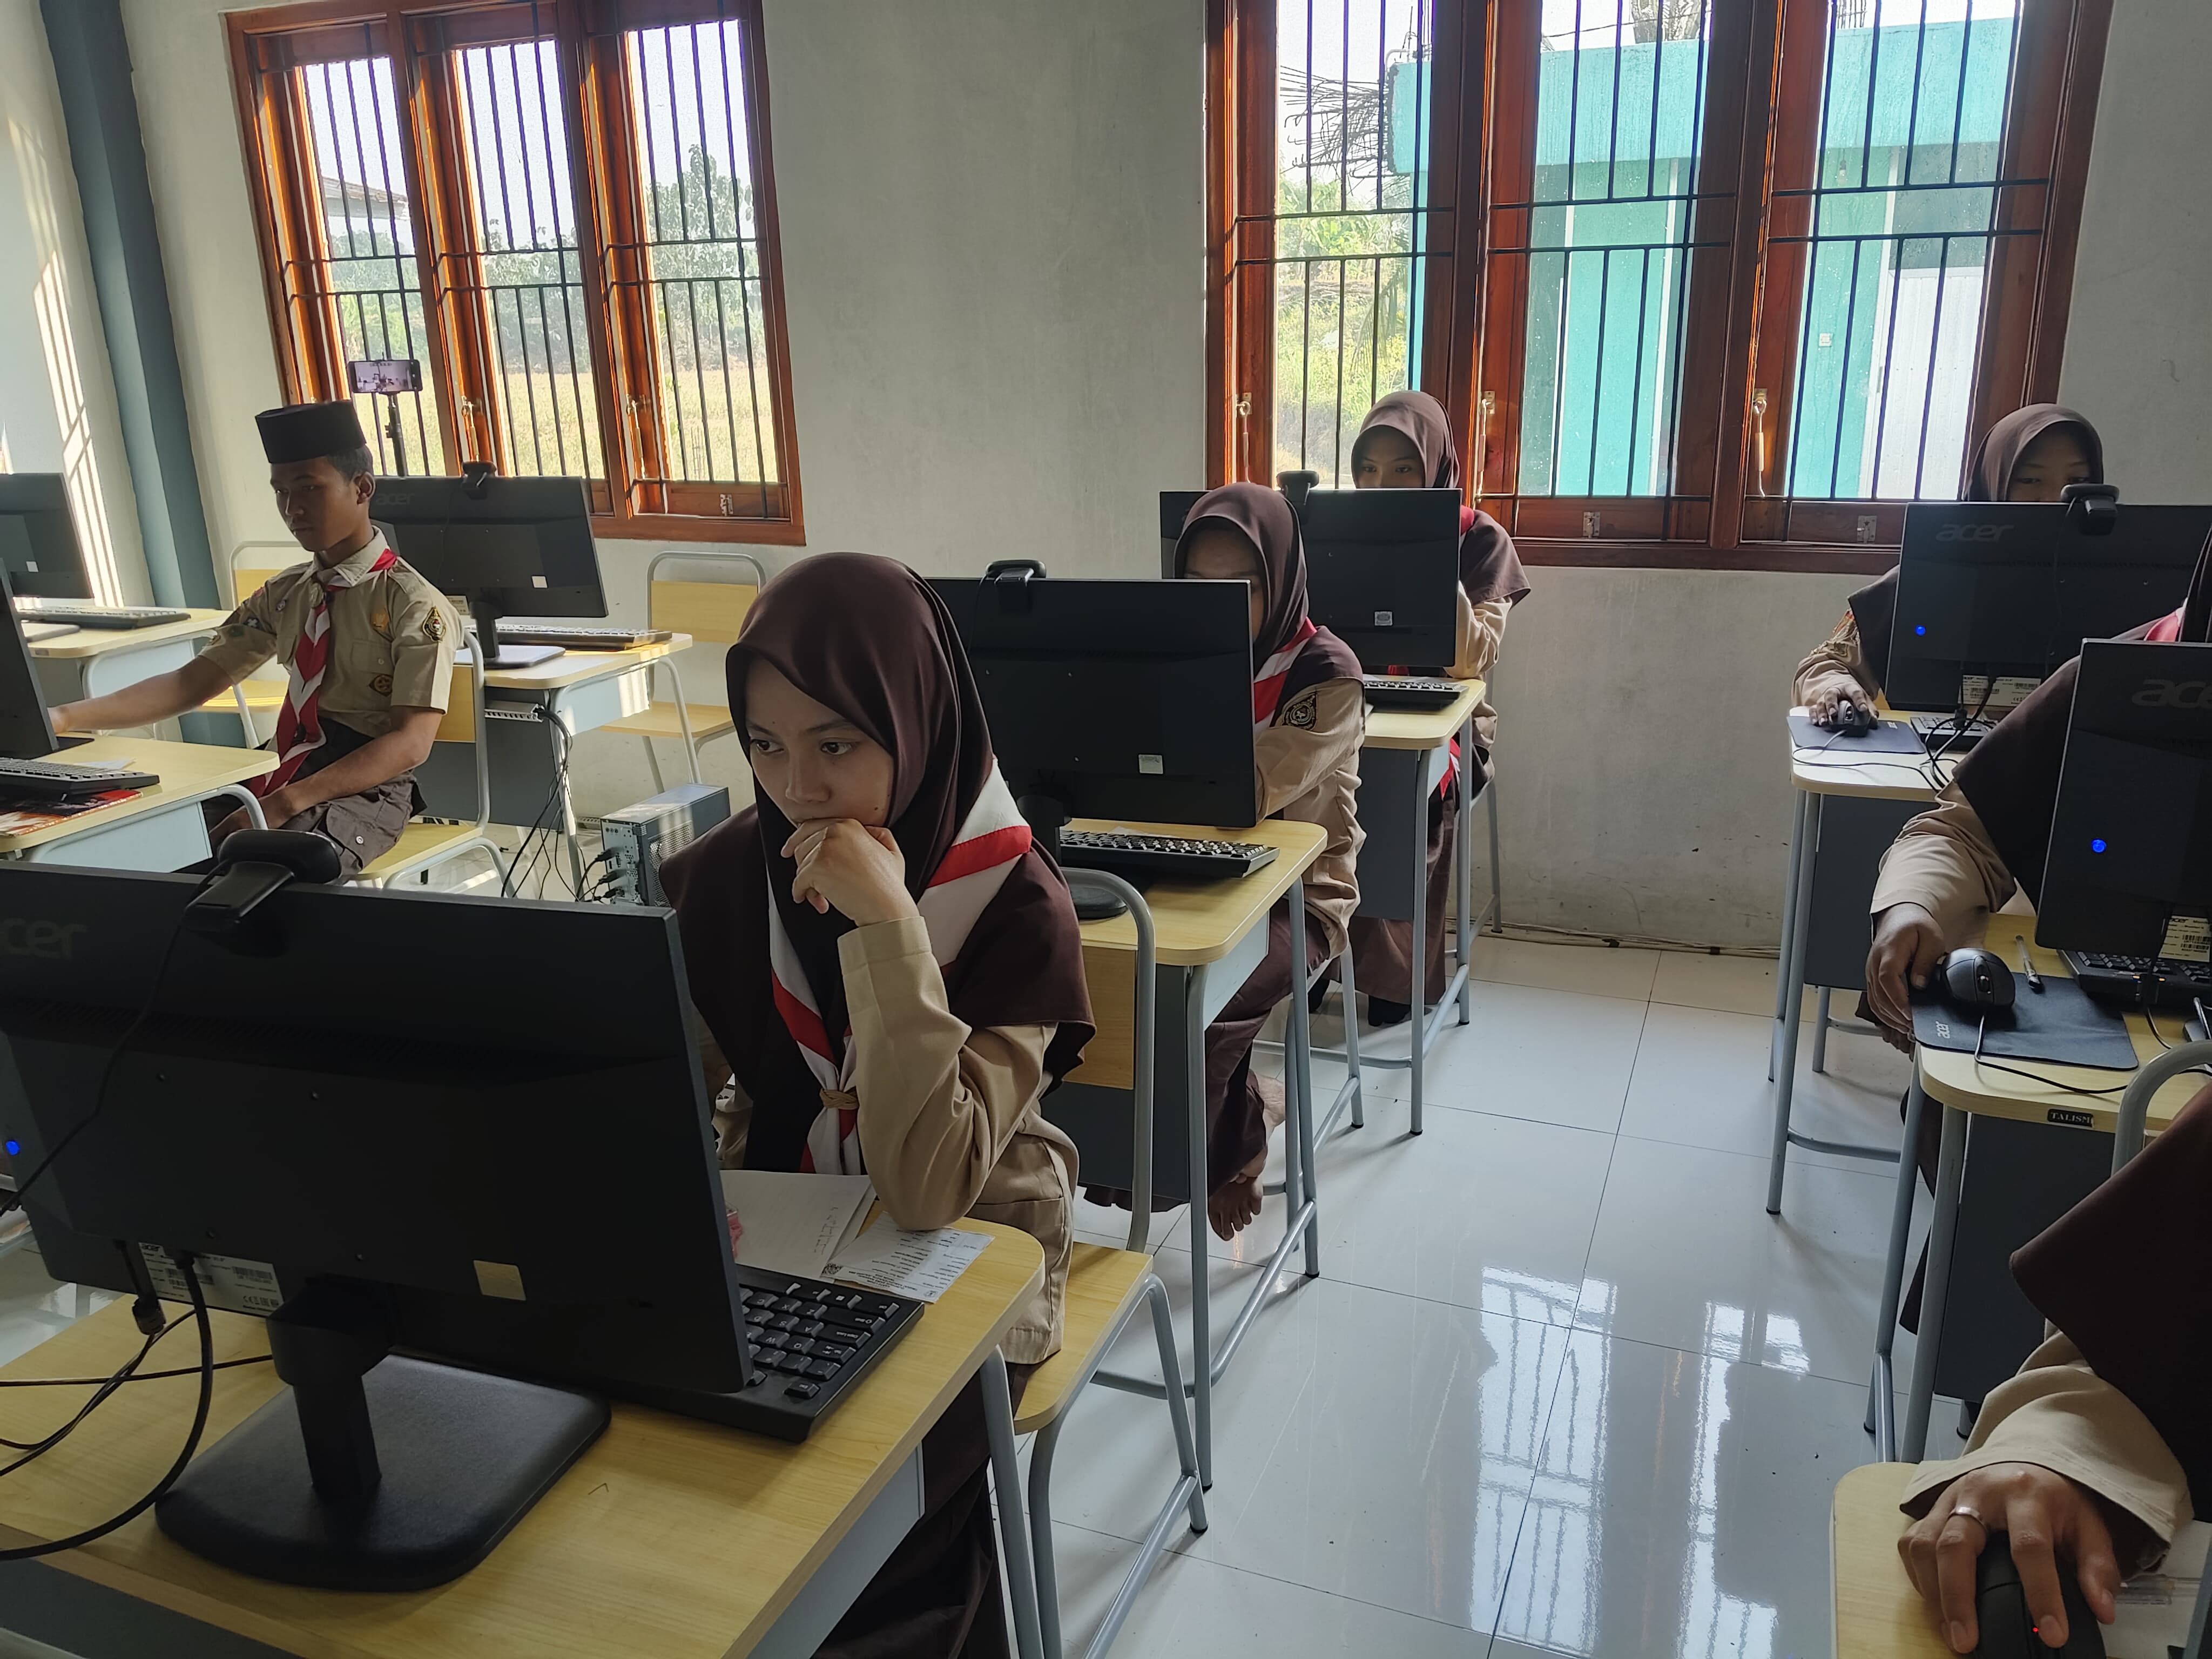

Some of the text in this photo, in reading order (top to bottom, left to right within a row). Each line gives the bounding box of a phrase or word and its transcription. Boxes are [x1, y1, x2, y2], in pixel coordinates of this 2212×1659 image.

[375, 492, 415, 505] acer
[1935, 523, 2015, 542] acer
[0, 917, 89, 960] cer
[1935, 1021, 1950, 1038] acer
